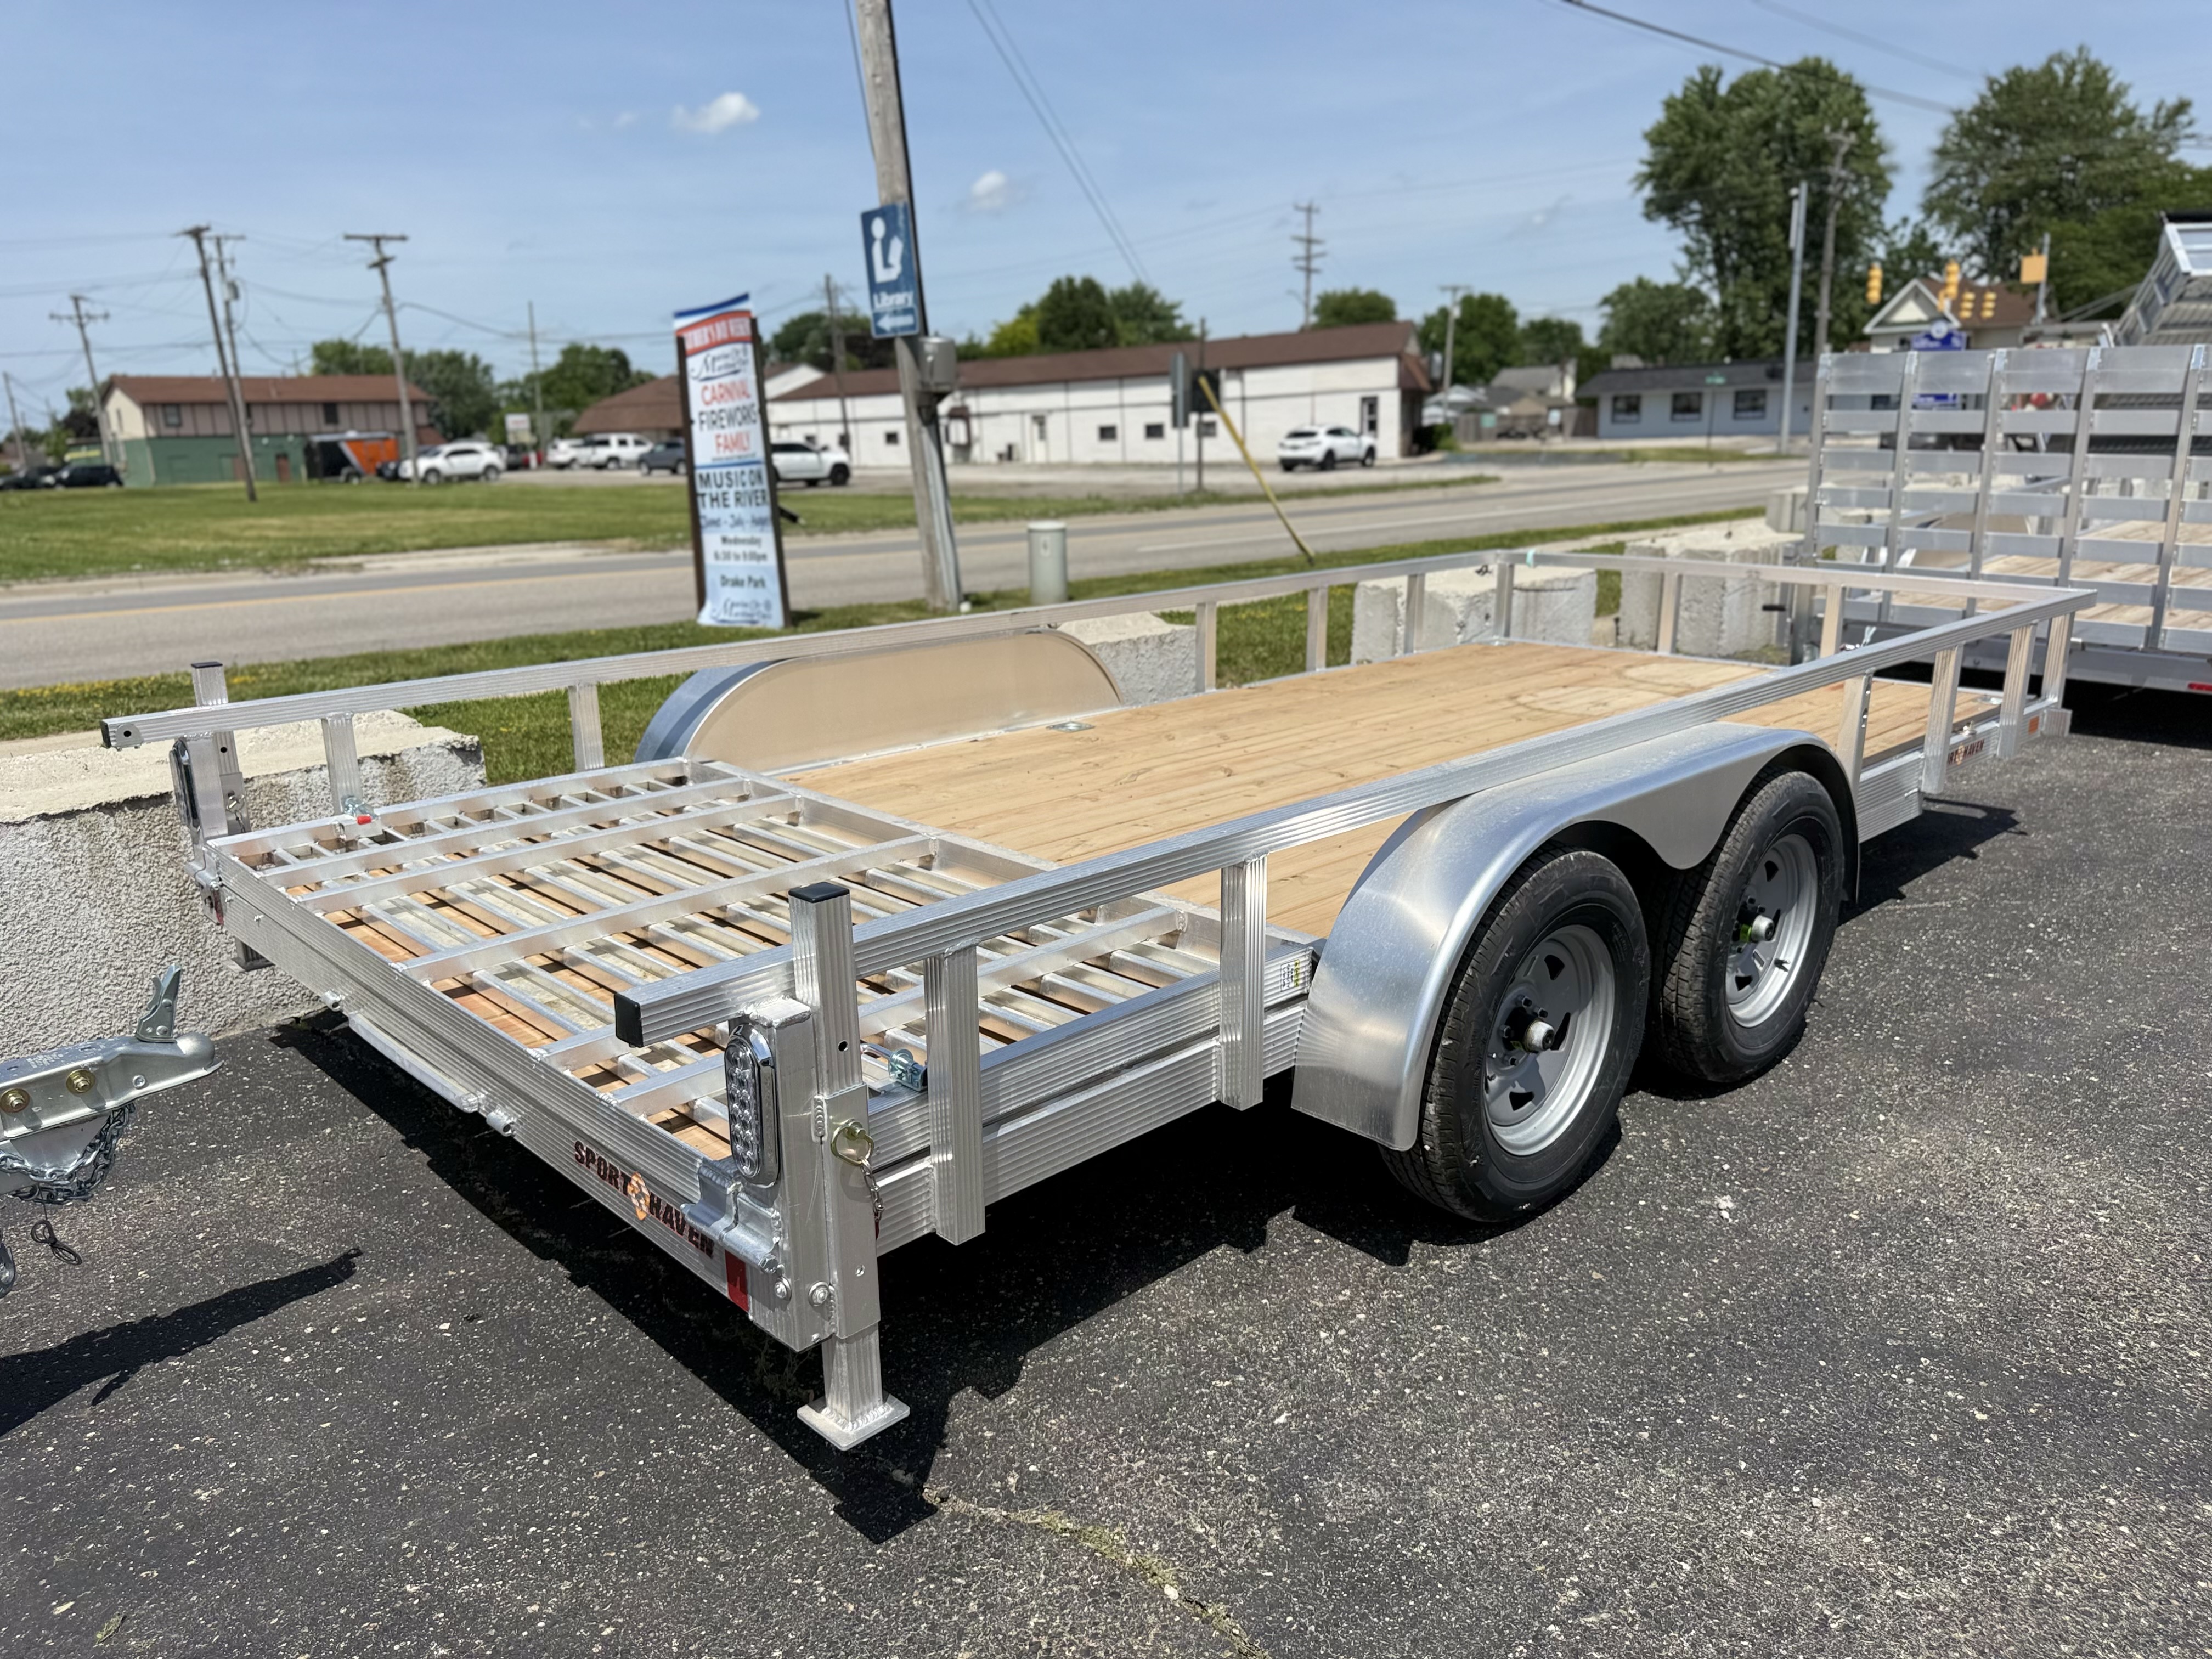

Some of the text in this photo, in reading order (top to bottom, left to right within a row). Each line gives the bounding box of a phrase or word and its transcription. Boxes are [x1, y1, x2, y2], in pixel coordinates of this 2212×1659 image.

[873, 291, 913, 309] Library
[701, 380, 751, 405] CARNIVAL
[698, 402, 757, 432] FIREWORKS
[715, 431, 751, 454] FAMILY
[698, 469, 763, 489] MUSIC ON
[697, 489, 768, 509] THE RIVER
[720, 574, 766, 589] Drake Park
[574, 1140, 715, 1259] SPORT HAVEN
